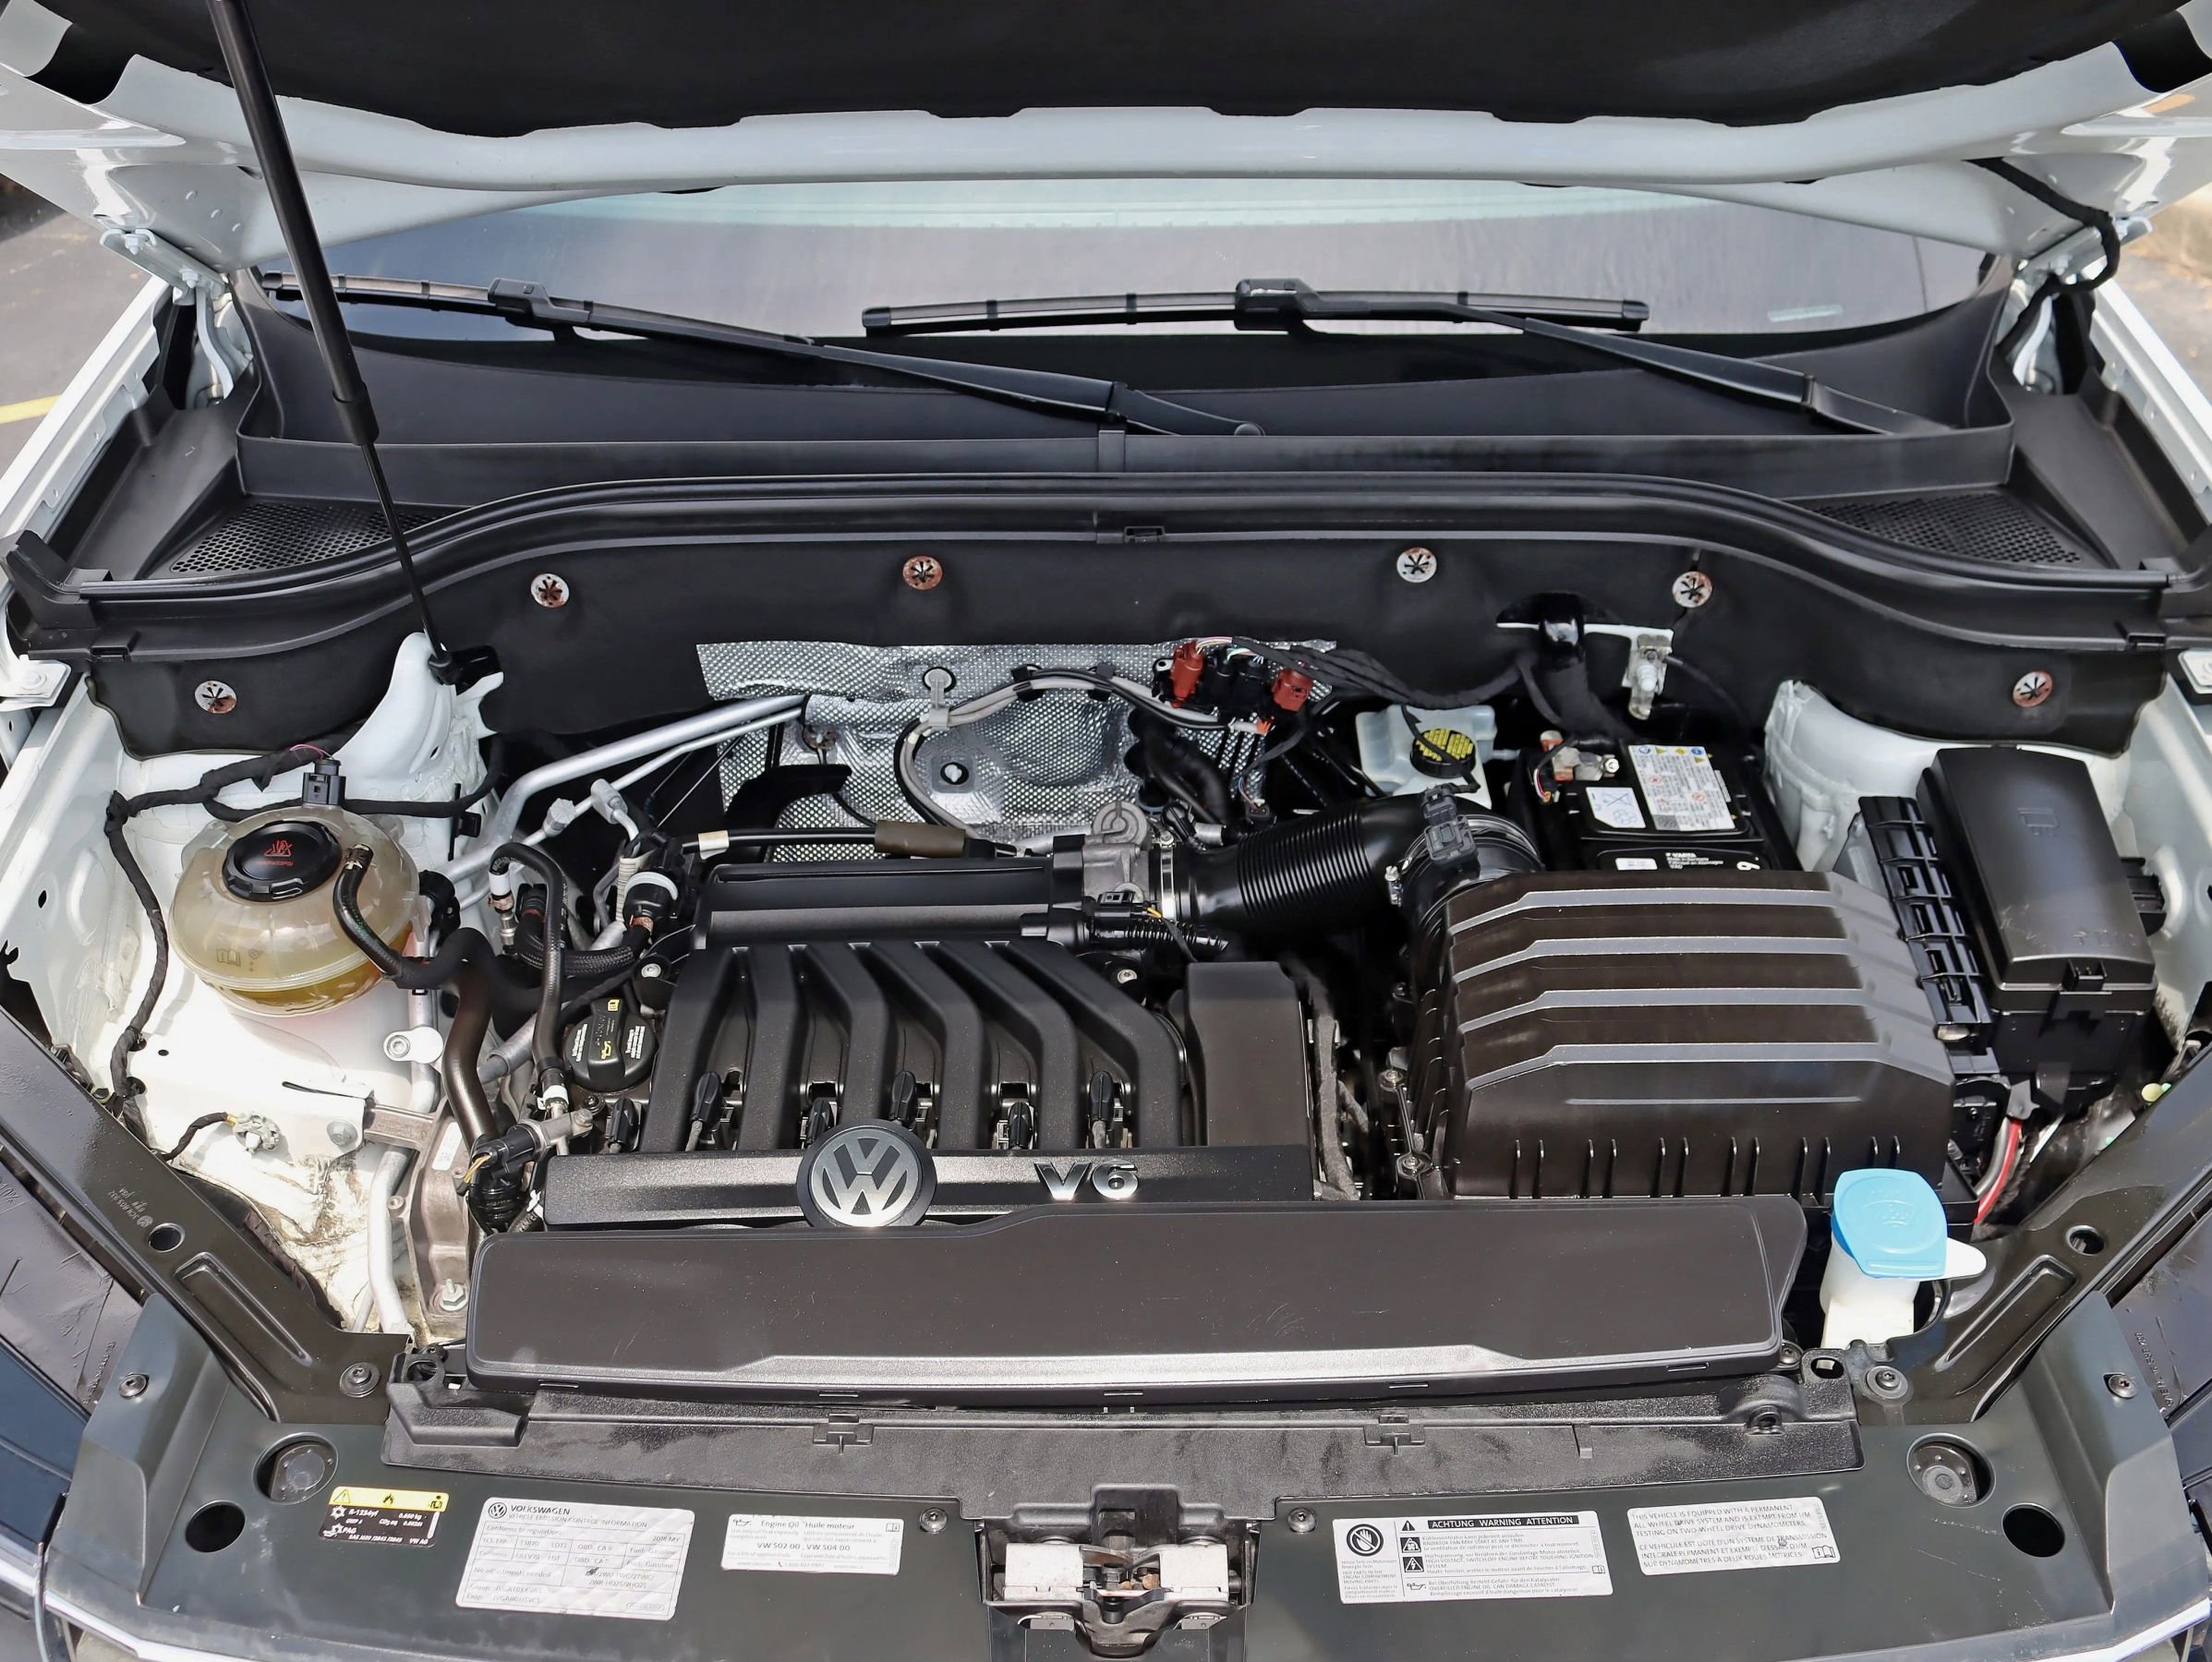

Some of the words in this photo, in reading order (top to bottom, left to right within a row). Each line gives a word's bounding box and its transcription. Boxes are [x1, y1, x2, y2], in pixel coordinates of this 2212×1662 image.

[811, 1127, 919, 1227] VW
[1034, 1160, 1139, 1201] V6
[348, 1509, 379, 1518] R-1234yf
[511, 1505, 571, 1515] VOLKSWAGEN
[1687, 1509, 1722, 1517] EQUIPPED
[1751, 1505, 1794, 1513] PERMANENT
[761, 1521, 786, 1529] Engine
[788, 1521, 800, 1529] Oil
[1432, 1520, 1475, 1528] ACHTUNG
[1479, 1517, 1522, 1526] WARNING
[1526, 1516, 1574, 1525] ATTENTION
[1777, 1532, 1828, 1541] TRANSMISSION
[806, 1544, 821, 1552] VW
[1680, 1548, 1719, 1557] PERMANENT
